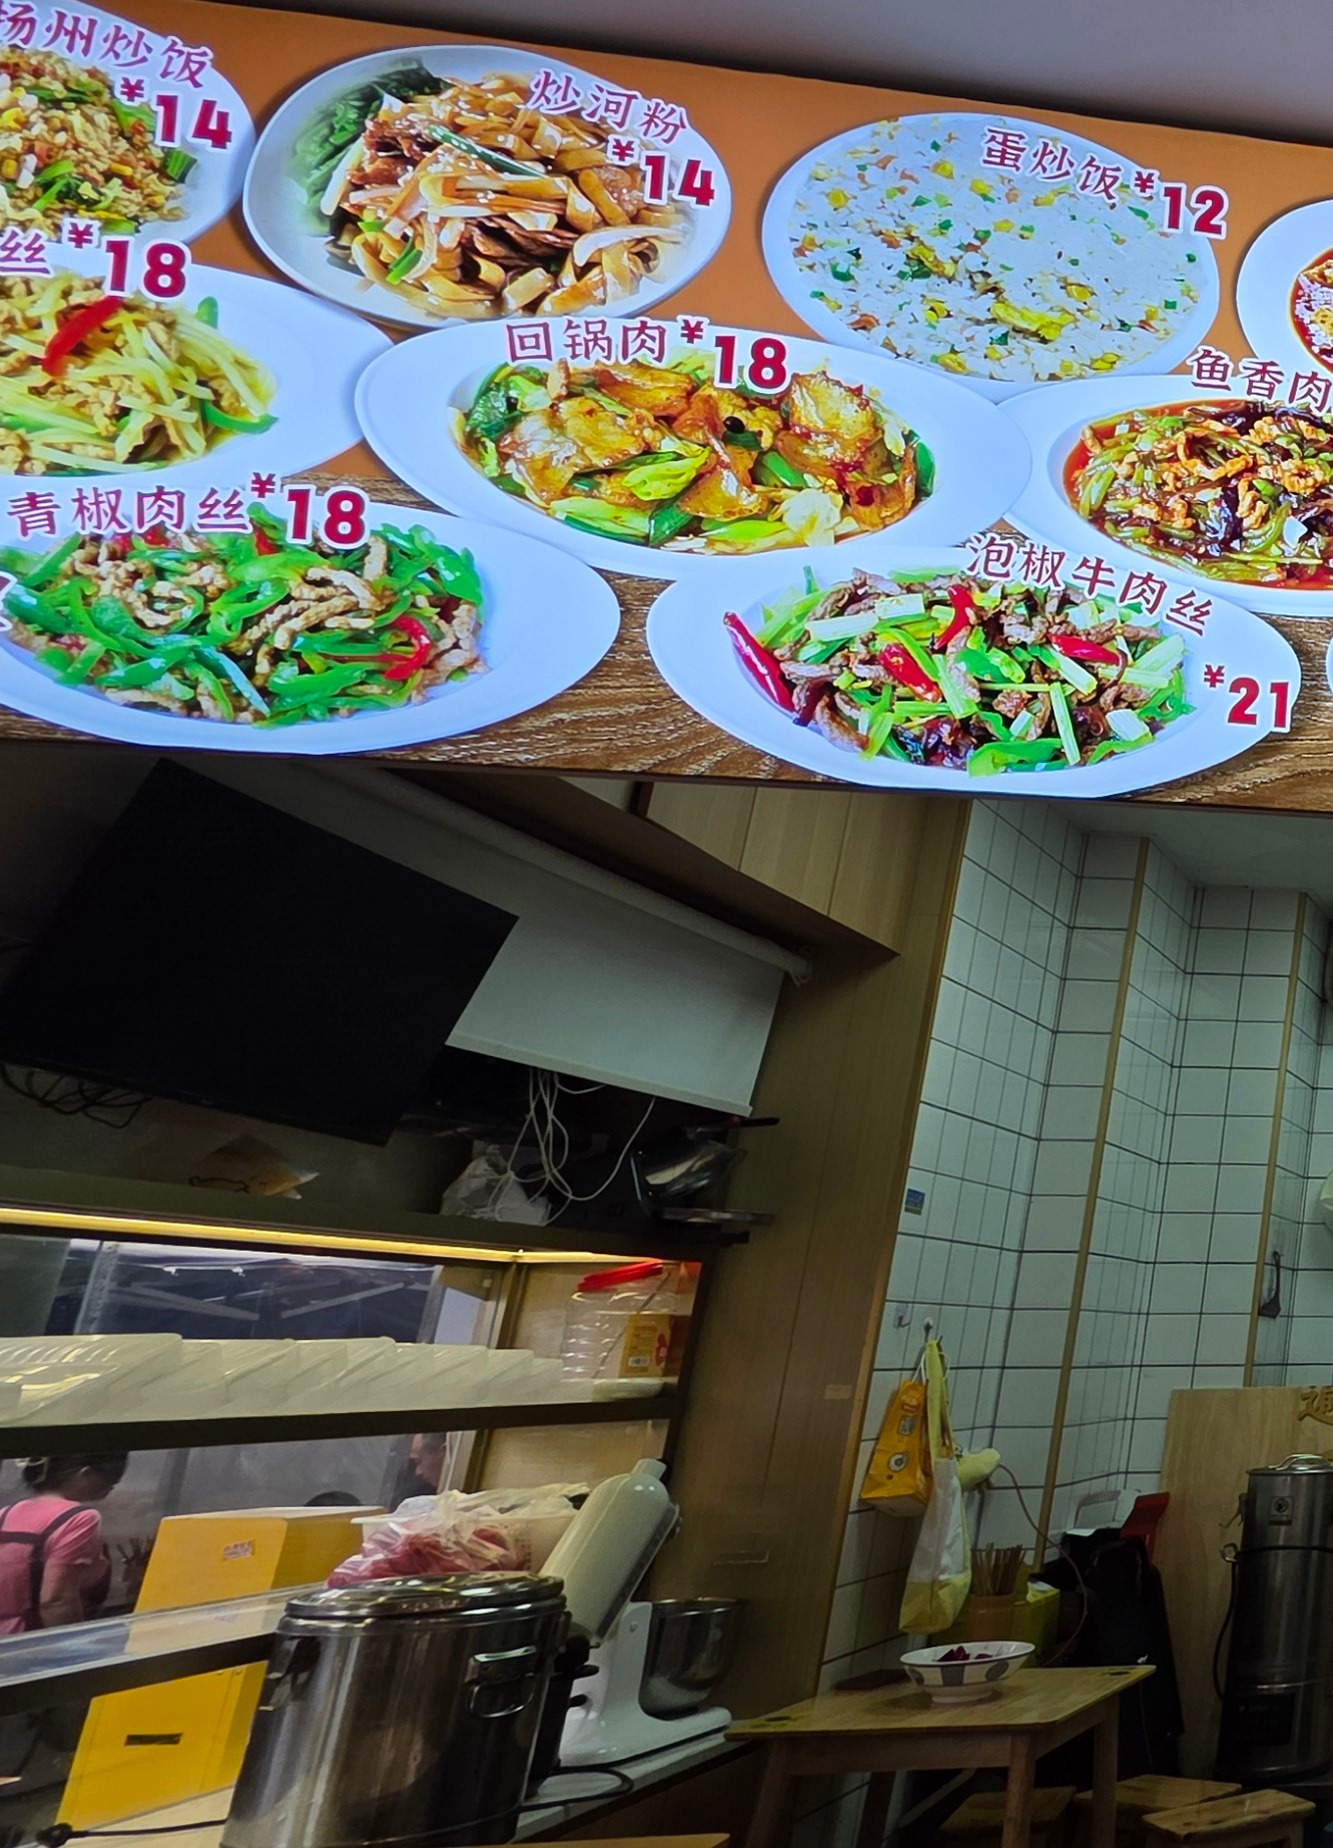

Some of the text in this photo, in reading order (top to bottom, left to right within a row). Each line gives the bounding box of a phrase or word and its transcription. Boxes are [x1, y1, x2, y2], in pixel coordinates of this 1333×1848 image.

[0, 3, 209, 89] 扬州炒饭
[120, 77, 232, 150] ¥14
[528, 68, 688, 144] 炒河粉
[611, 139, 716, 207] ¥14
[983, 129, 1119, 199] 蛋炒饭
[1133, 172, 1228, 238] ¥12
[68, 222, 186, 298] ¥18
[508, 320, 667, 366] 回锅肉
[679, 317, 788, 391] ¥18
[9, 487, 247, 538] 青椒肉丝
[250, 473, 367, 547] ¥18
[967, 531, 1211, 636] 泡椒牛肉丝
[1201, 664, 1292, 730] ¥21
